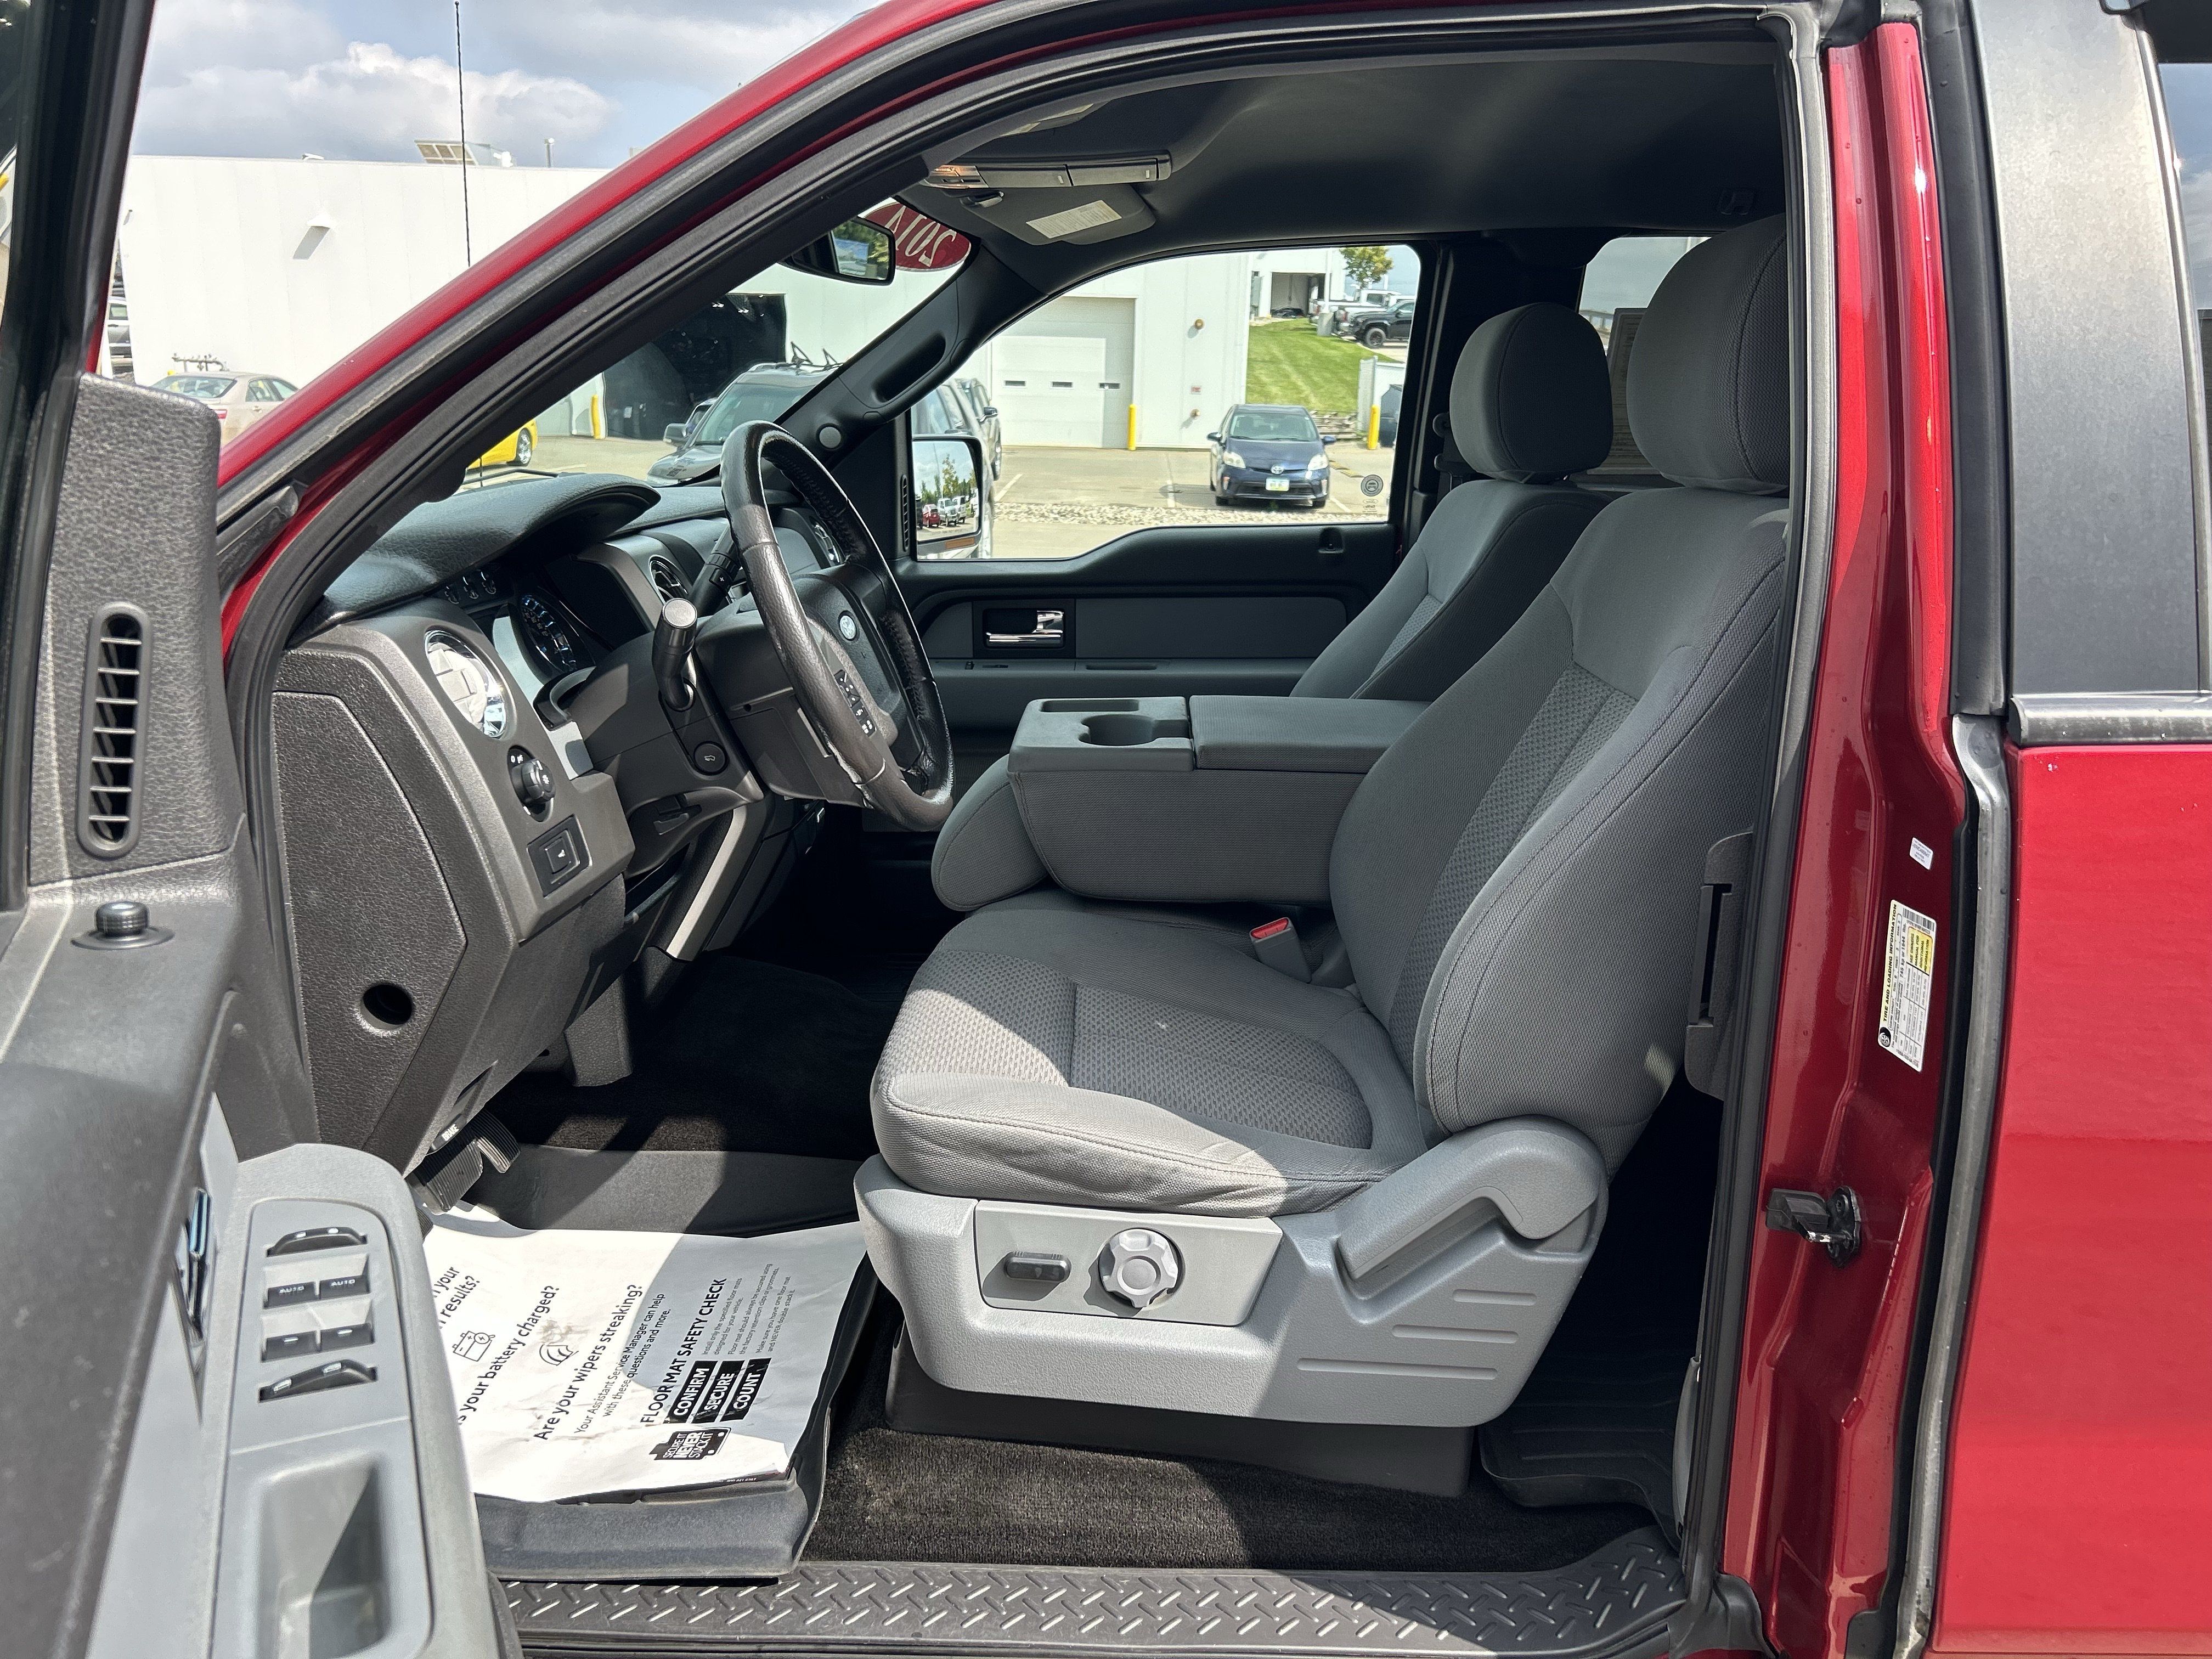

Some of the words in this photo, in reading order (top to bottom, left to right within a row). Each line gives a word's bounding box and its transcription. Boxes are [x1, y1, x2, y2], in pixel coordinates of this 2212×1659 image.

[331, 1279, 355, 1287] AUTO
[434, 1267, 460, 1290] your
[441, 1276, 480, 1317] results?
[460, 1381, 489, 1412] your
[477, 1338, 526, 1379] battery
[517, 1285, 559, 1337] charged?
[533, 1418, 560, 1440] Are
[552, 1385, 579, 1415] your
[572, 1345, 606, 1382] wipers
[600, 1284, 642, 1342] streaking?
[574, 1416, 594, 1434] Your
[588, 1379, 615, 1414] Assistant
[607, 1355, 630, 1380] Service
[623, 1323, 648, 1353] Manager
[644, 1307, 656, 1322] can
[652, 1293, 665, 1309] help
[603, 1402, 619, 1417] with
[613, 1379, 631, 1400] these
[627, 1341, 652, 1378] questions
[647, 1329, 659, 1343] and
[655, 1309, 671, 1328] more.
[640, 1385, 674, 1423] FLOOR
[663, 1358, 687, 1383] MAT
[677, 1318, 708, 1357] SAFETY
[699, 1278, 727, 1317] CHECK
[673, 1368, 710, 1415] CONFIRM
[704, 1373, 735, 1410] SECURE
[733, 1373, 761, 1409] COUNT
[673, 1432, 703, 1459] NEVER
[689, 1439, 709, 1458] STACK
